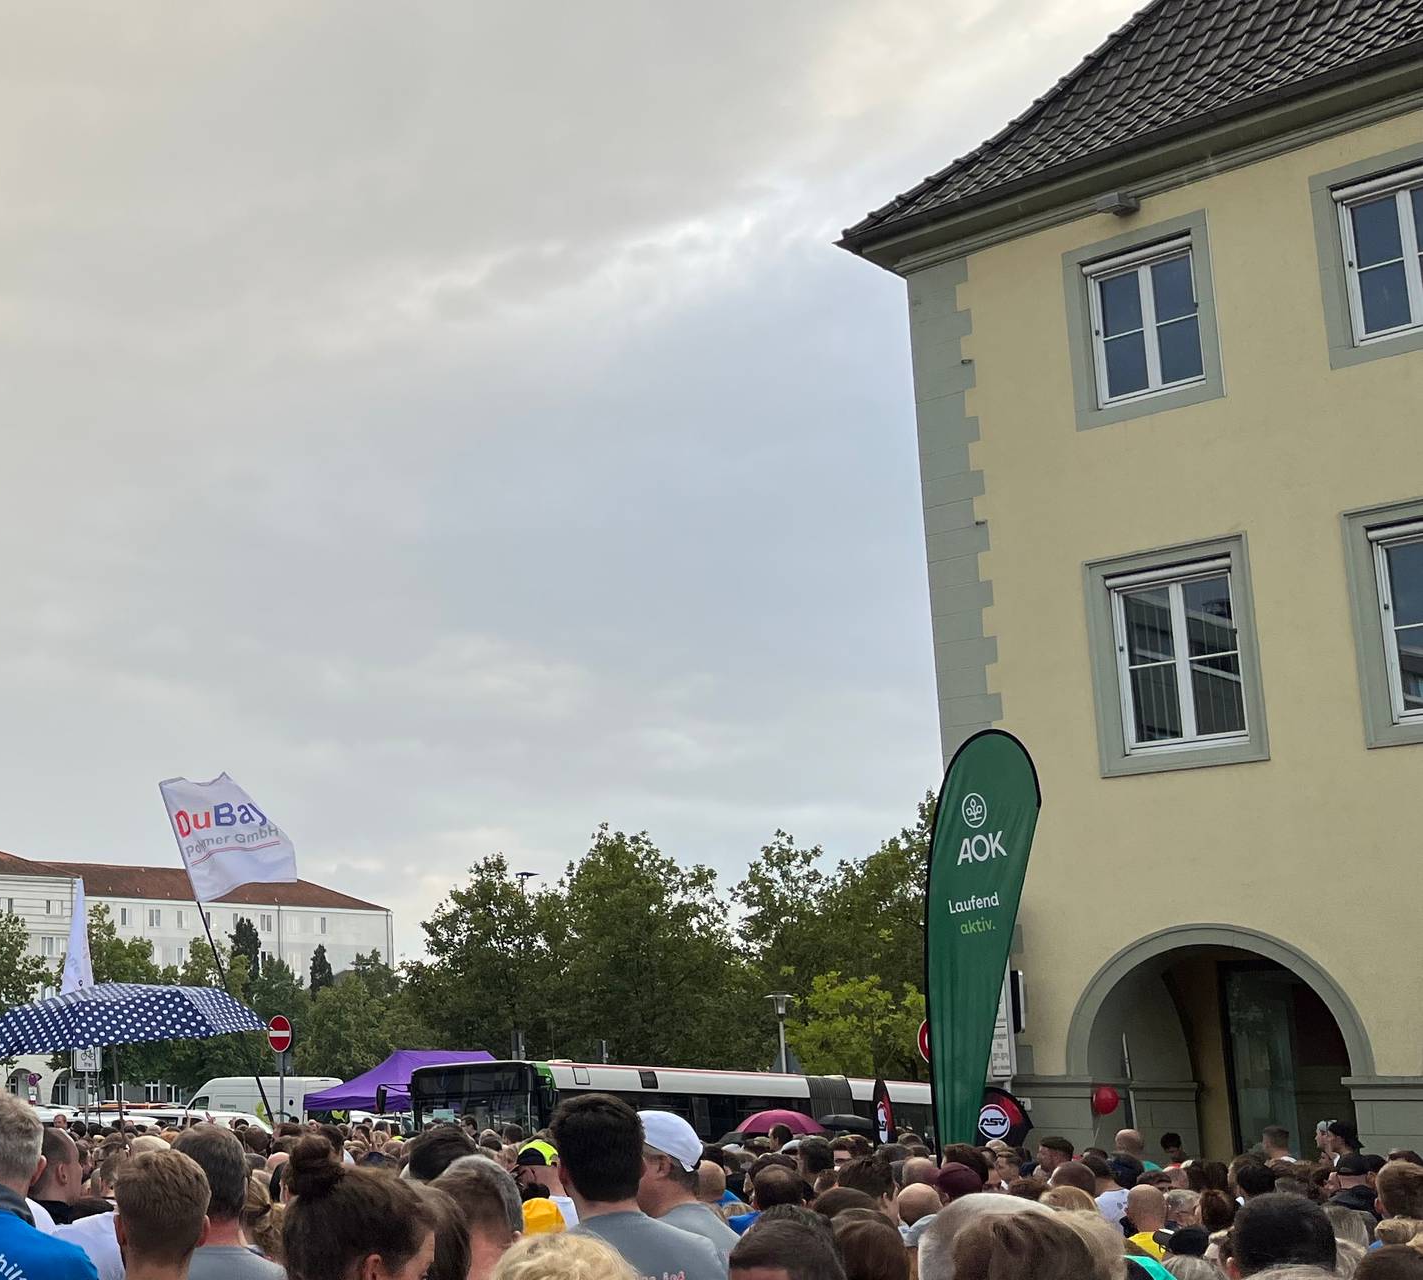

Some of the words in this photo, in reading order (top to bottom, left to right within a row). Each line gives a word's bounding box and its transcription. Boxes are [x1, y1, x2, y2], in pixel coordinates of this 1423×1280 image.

[234, 825, 279, 844] GmbH
[956, 830, 1007, 866] AOK
[948, 891, 1000, 914] Laufend
[979, 1117, 1009, 1127] ASV
